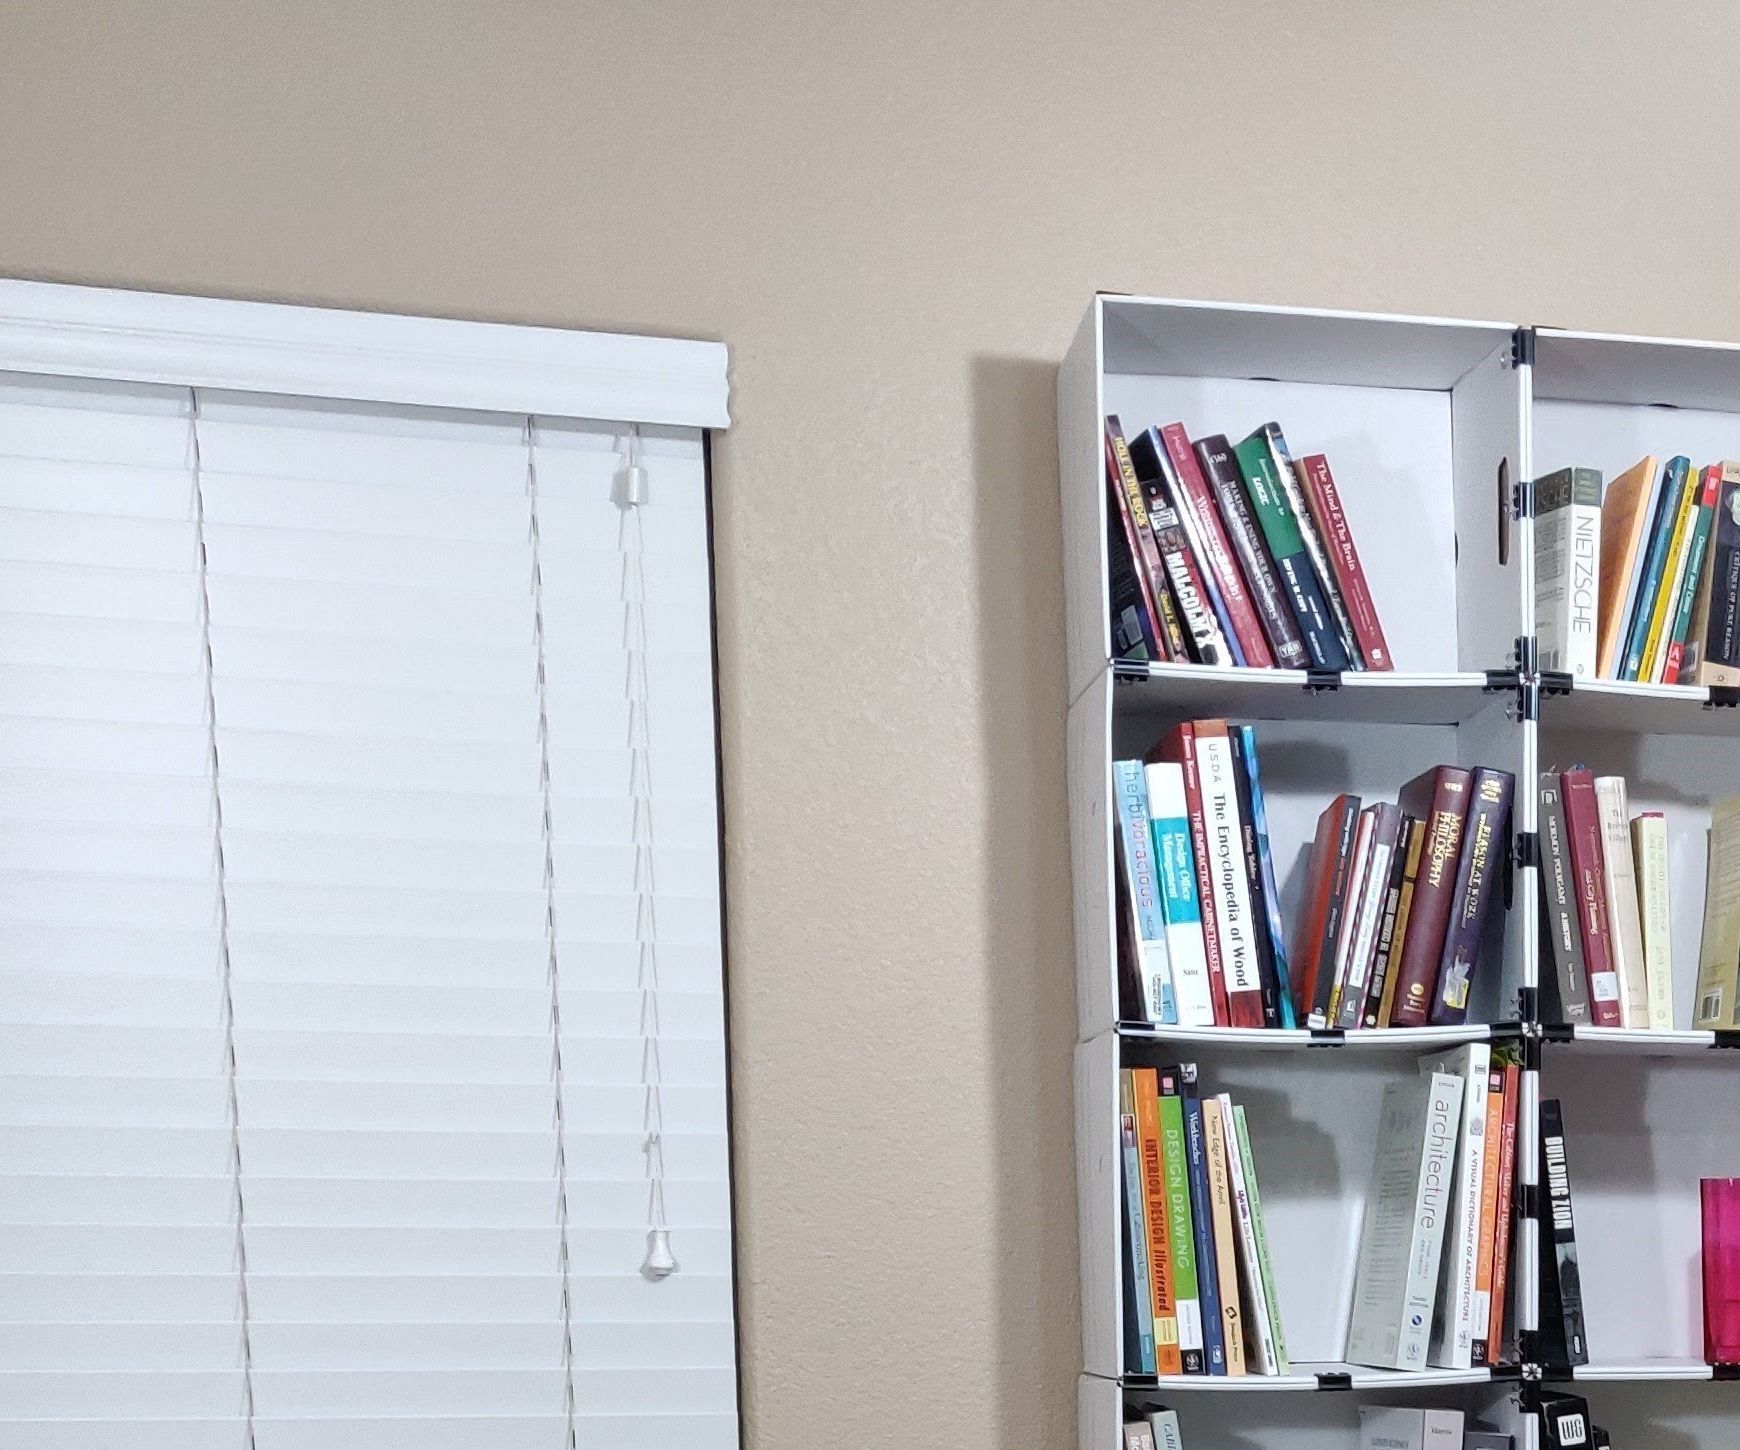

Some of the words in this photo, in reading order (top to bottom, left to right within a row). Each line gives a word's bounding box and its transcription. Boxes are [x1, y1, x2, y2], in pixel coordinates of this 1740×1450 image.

[1252, 476, 1270, 507] LOGIC
[1164, 550, 1209, 634] MALCOLM
[1572, 515, 1593, 632] NIETZSCHE
[1207, 742, 1221, 783] USDA
[1213, 793, 1227, 820] The
[1427, 810, 1452, 887] PHILOSOPHY
[1443, 814, 1461, 861] MORAL
[1214, 825, 1241, 921] Encyclopedia
[1230, 926, 1243, 944] of
[1232, 946, 1249, 987] Wood
[1144, 1138, 1161, 1197] INTERIOR
[1165, 1128, 1182, 1188] DESIGN
[1211, 1137, 1221, 1156] Edge
[1420, 1099, 1456, 1230] architecture
[1469, 1158, 1477, 1187] VISUAL
[1544, 1135, 1568, 1196] BUILDING
[1149, 1200, 1165, 1244] DESIGN
[1171, 1192, 1189, 1269] DRAWING
[1466, 1190, 1475, 1243] DICTIONARY
[1550, 1198, 1572, 1230] ZION
[1465, 1245, 1472, 1256] OF
[1153, 1248, 1170, 1310] Illustrated
[1461, 1258, 1471, 1321] ARCHITECTURE
